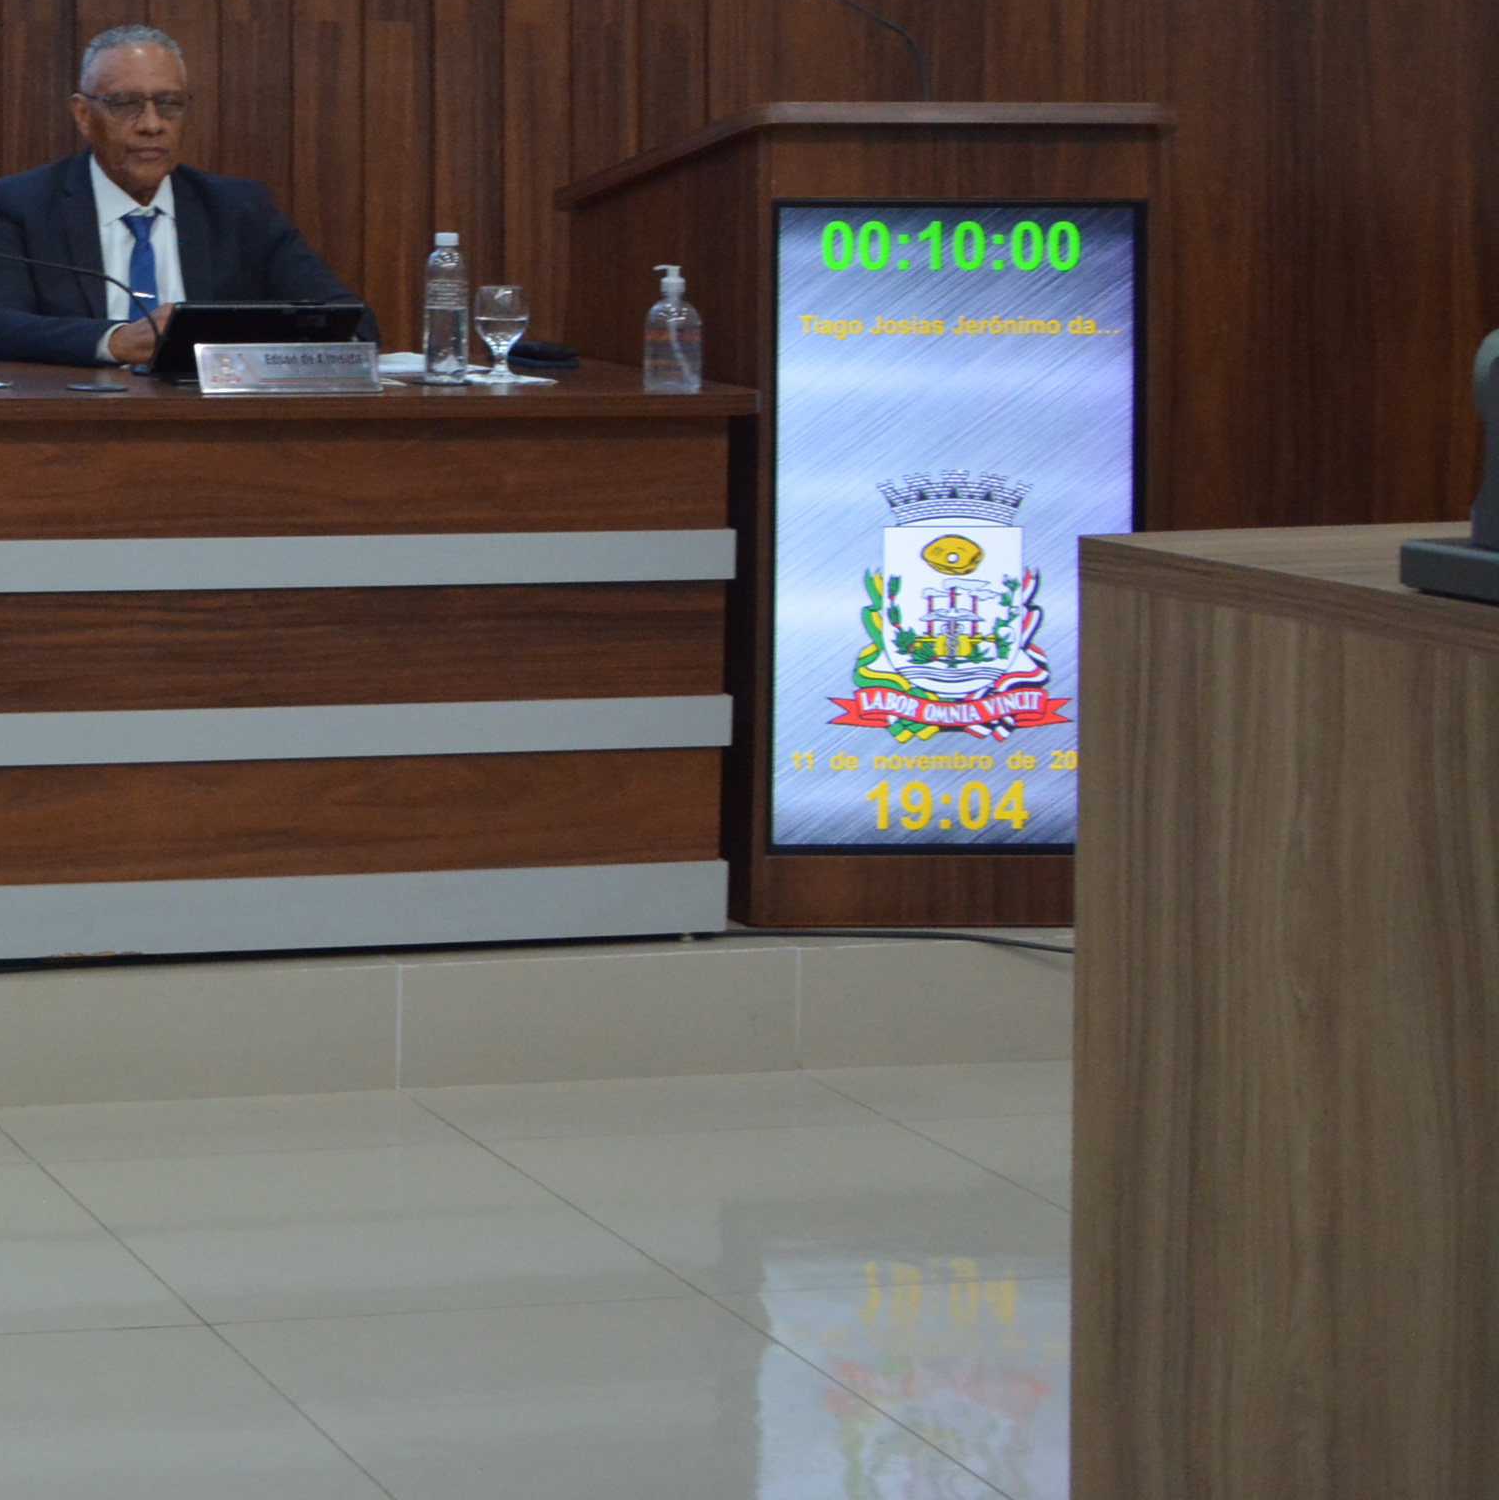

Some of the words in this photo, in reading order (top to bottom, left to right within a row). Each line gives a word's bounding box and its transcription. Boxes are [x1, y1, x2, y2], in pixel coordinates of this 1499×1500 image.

[821, 219, 1082, 272] 00:10:00
[800, 315, 864, 340] Tiago
[870, 315, 945, 335] Josias
[860, 690, 920, 718] LABOR
[922, 703, 982, 723] OMNIA
[982, 690, 1043, 717] VINCIT
[792, 751, 815, 770] 11
[830, 751, 859, 771] de
[874, 751, 994, 771] novembro
[1007, 750, 1037, 771] de
[1050, 750, 1078, 770] 20
[866, 780, 1030, 831] 19:04
